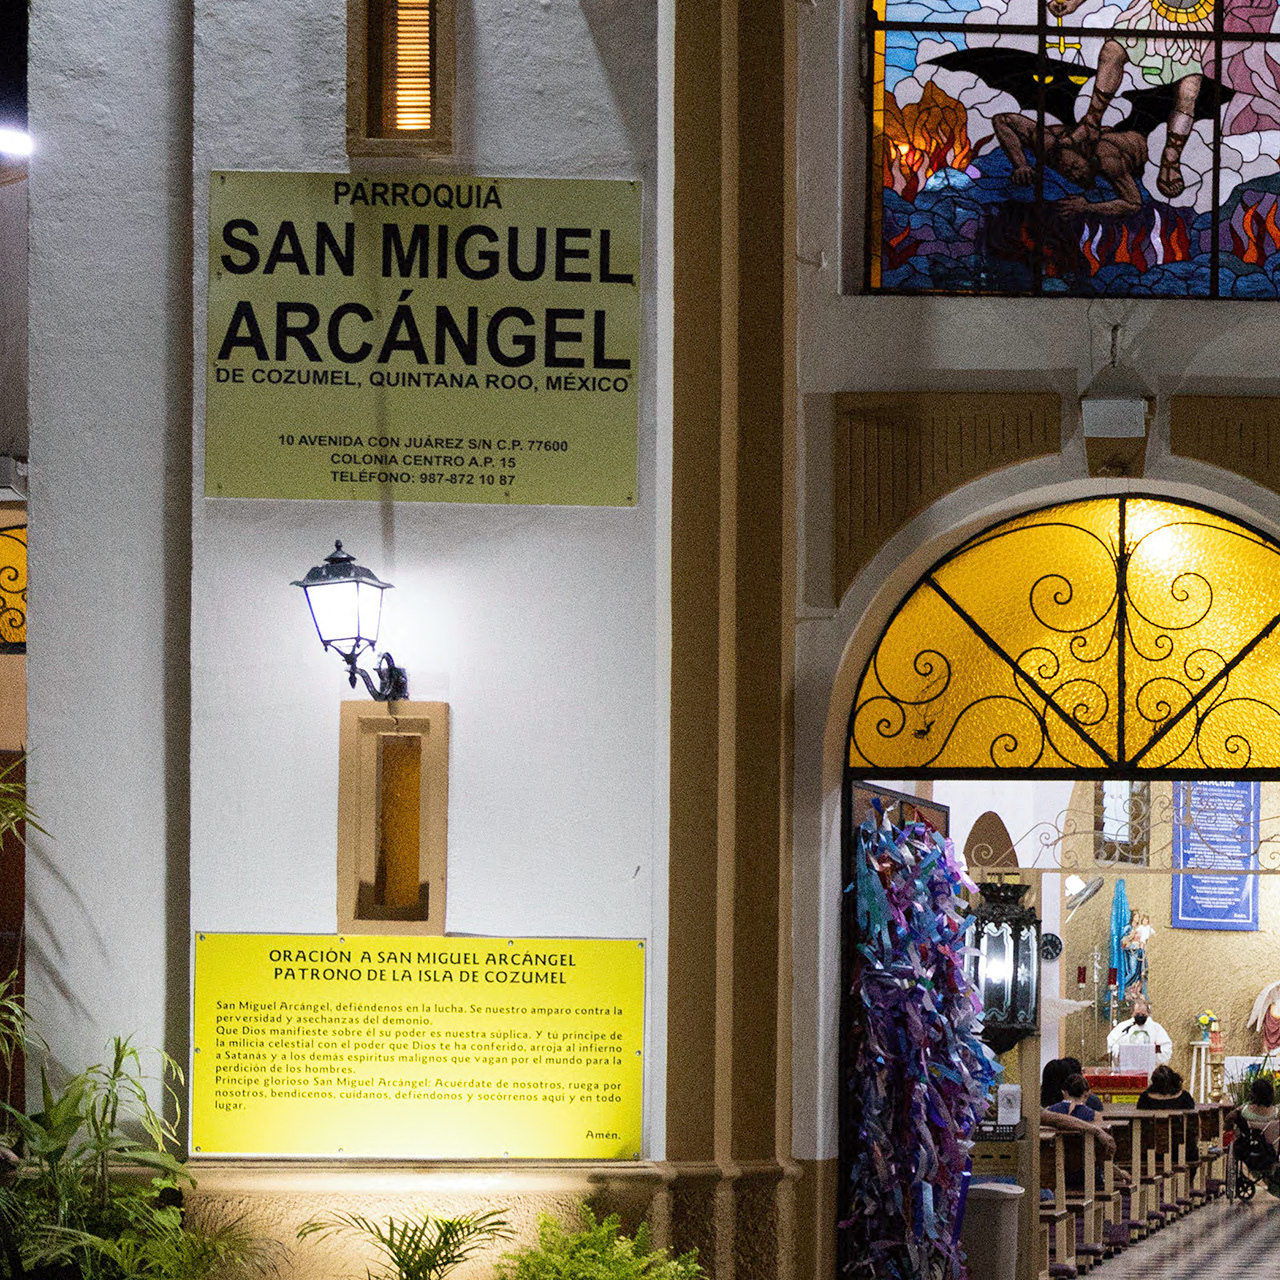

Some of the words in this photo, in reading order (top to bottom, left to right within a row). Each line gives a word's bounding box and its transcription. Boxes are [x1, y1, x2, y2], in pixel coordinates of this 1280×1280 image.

[334, 181, 501, 209] PARROQUIA
[220, 218, 355, 277] SAN
[381, 223, 634, 284] MIGUEL
[218, 289, 631, 370] ARCÁNGEL
[216, 368, 244, 383] DE
[252, 369, 361, 387] COZUMEL,
[370, 371, 479, 388] QUINTANA
[486, 374, 538, 392] ROO,
[545, 373, 628, 393] MÉXICO
[279, 435, 294, 445] 10
[298, 435, 363, 446] AVENIDA
[368, 436, 399, 448] CON
[404, 434, 462, 450] JUÁREZ
[469, 439, 491, 449] S/N
[497, 439, 522, 450] C.P.
[528, 440, 568, 451] 77600
[331, 453, 398, 465] COLONIA
[403, 455, 464, 466] CENTRO
[469, 456, 495, 468] A.P.
[500, 457, 516, 468] 15
[331, 468, 415, 484] TELÉFONO:
[420, 473, 474, 484] 987-872
[479, 474, 494, 485] 10
[499, 475, 515, 485] 87
[269, 948, 352, 964] ORACIÓN
[361, 951, 371, 962] A
[377, 951, 412, 965] SAN
[417, 952, 480, 966] MIGUEL
[485, 950, 576, 968] ARCÁNGEL
[275, 968, 361, 980] PATRONO
[368, 969, 385, 981] DE
[393, 970, 412, 981] LA
[419, 970, 453, 982] ISLA
[460, 971, 478, 982] DE
[485, 971, 566, 984] COZUMEL
[270, 1064, 282, 1072] de
[286, 1064, 301, 1073] los
